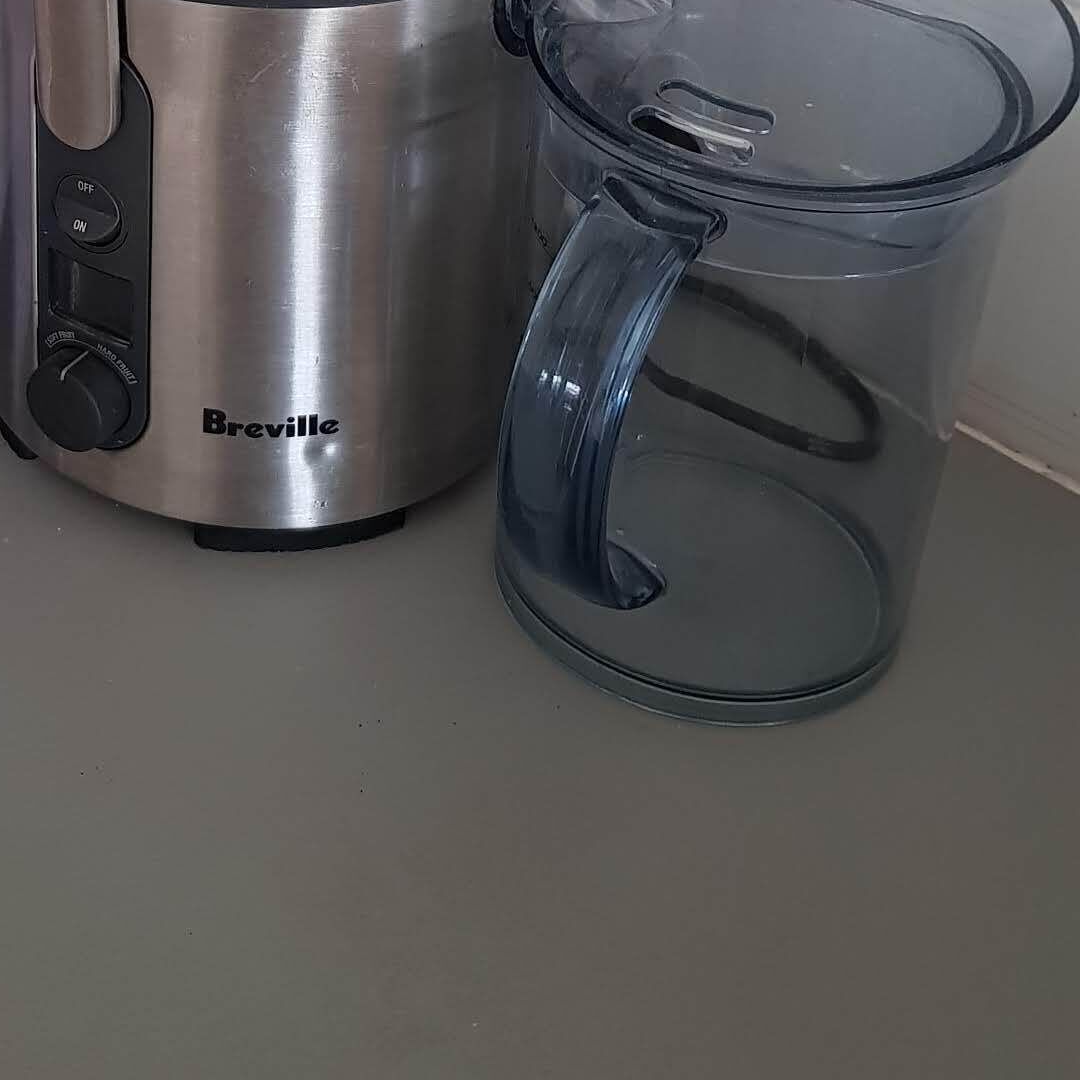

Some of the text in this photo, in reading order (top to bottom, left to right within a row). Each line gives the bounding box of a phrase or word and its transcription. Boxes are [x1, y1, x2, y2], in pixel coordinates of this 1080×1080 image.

[77, 180, 95, 194] OFF
[73, 219, 88, 233] ON
[203, 408, 340, 439] Breville
